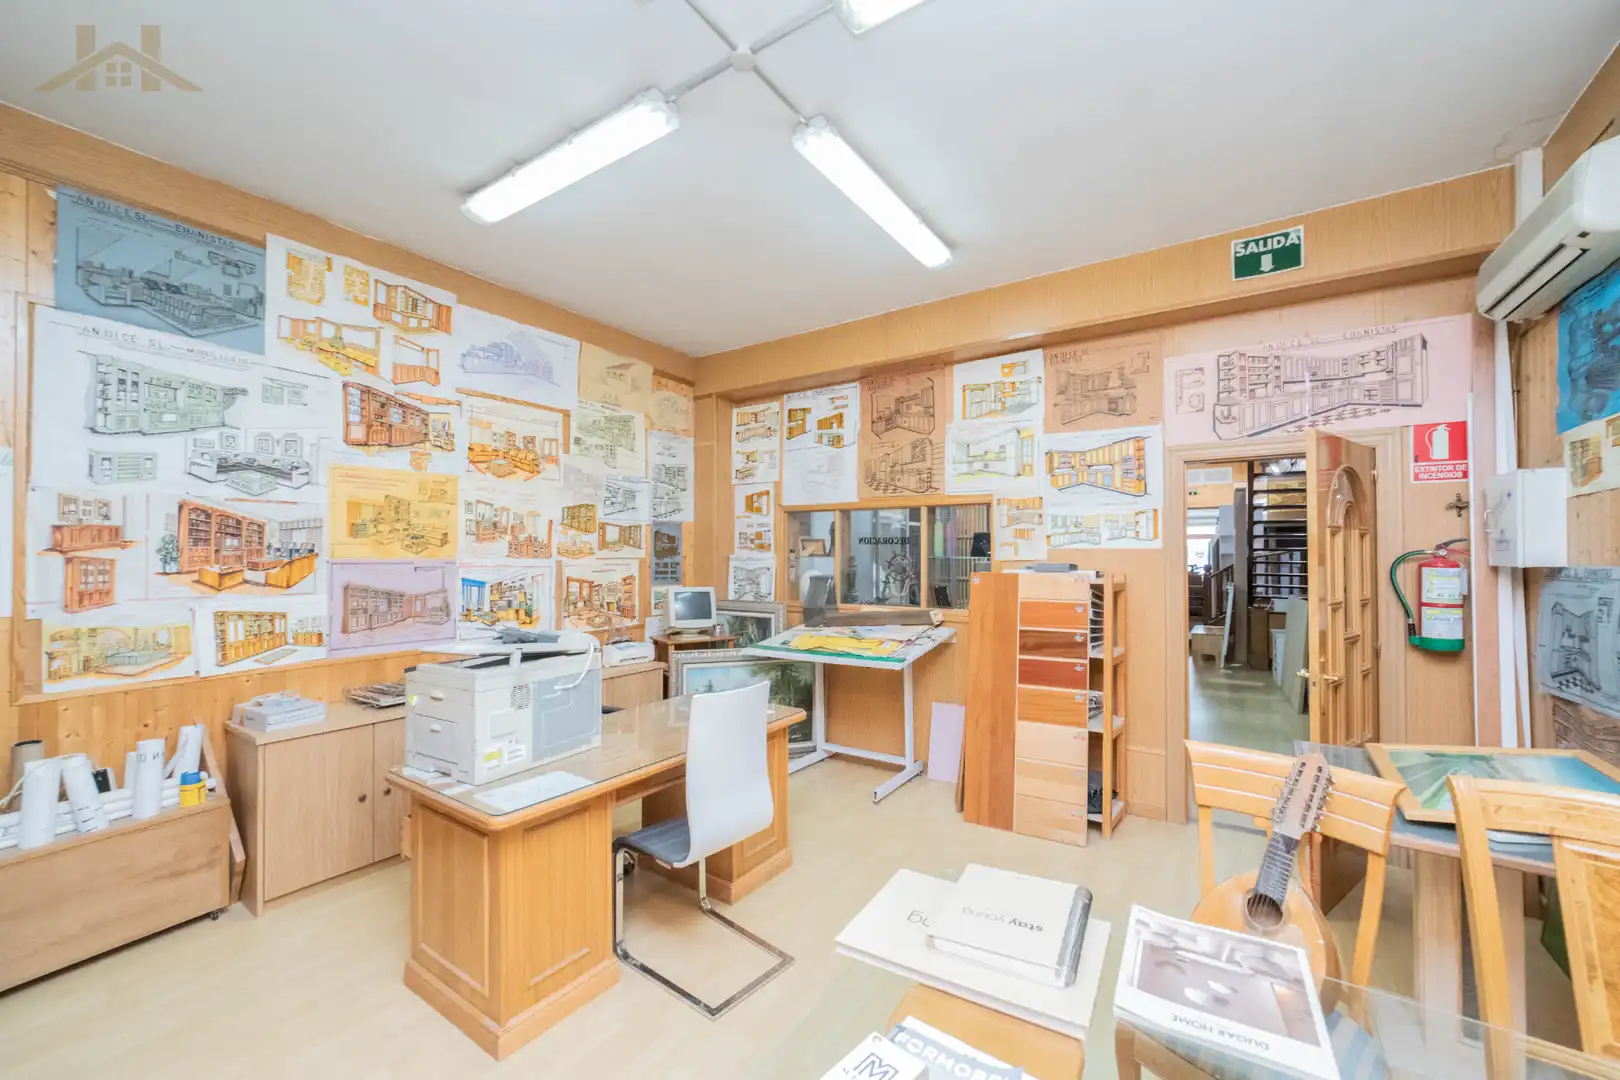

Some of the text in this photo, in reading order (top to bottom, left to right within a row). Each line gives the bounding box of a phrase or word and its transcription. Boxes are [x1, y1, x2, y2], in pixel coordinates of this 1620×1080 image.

[1235, 231, 1300, 257] SALIDA
[1414, 463, 1467, 473] EXTINTOR DE
[1419, 471, 1463, 480] INCENDIOS
[962, 906, 1044, 933] stay young
[1171, 1012, 1269, 1051] DUGAR HOME
